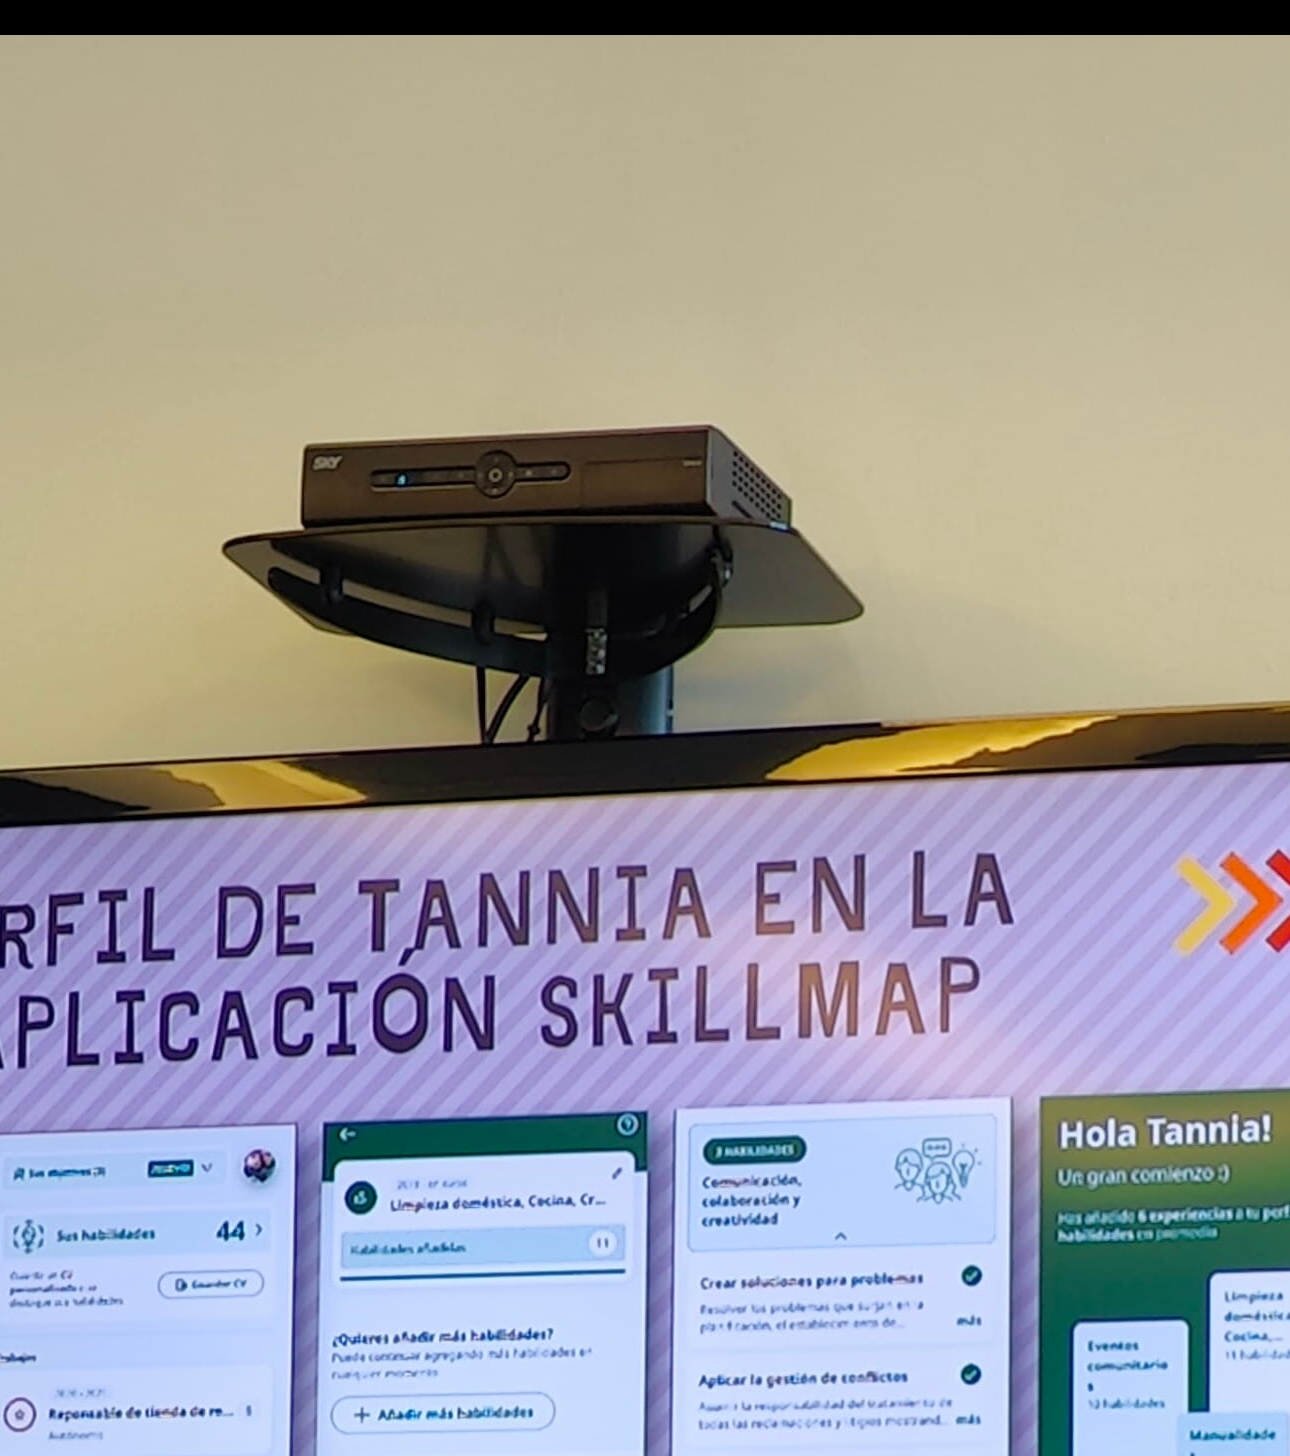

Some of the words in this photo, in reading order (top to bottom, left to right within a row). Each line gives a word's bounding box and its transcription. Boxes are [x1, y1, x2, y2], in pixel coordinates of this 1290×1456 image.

[216, 883, 316, 959] DE
[358, 866, 712, 952] TANNIA
[755, 853, 865, 935] EN
[912, 850, 1014, 929] LA
[540, 956, 981, 1048] SKILLMAP
[1060, 1117, 1136, 1149] Hola
[1147, 1113, 1272, 1146] Tannia!
[1058, 1169, 1084, 1186] Un
[1087, 1168, 1126, 1190] gran
[1131, 1164, 1215, 1184] comienzo
[793, 1196, 801, 1209] y
[701, 1213, 779, 1227] creatividad
[57, 1230, 78, 1242] Sus
[82, 1228, 155, 1241] habilidades
[217, 1220, 245, 1242] 44
[700, 1277, 737, 1290] Crear
[816, 1274, 847, 1290] para
[851, 1272, 924, 1287] problemas
[439, 1331, 466, 1342] más
[750, 1374, 763, 1386] la
[821, 1371, 837, 1385] de
[126, 1407, 141, 1419] de
[190, 1406, 205, 1418] de
[377, 1408, 422, 1421] Añadir
[426, 1407, 453, 1420] más
[457, 1406, 534, 1420] habilidades
